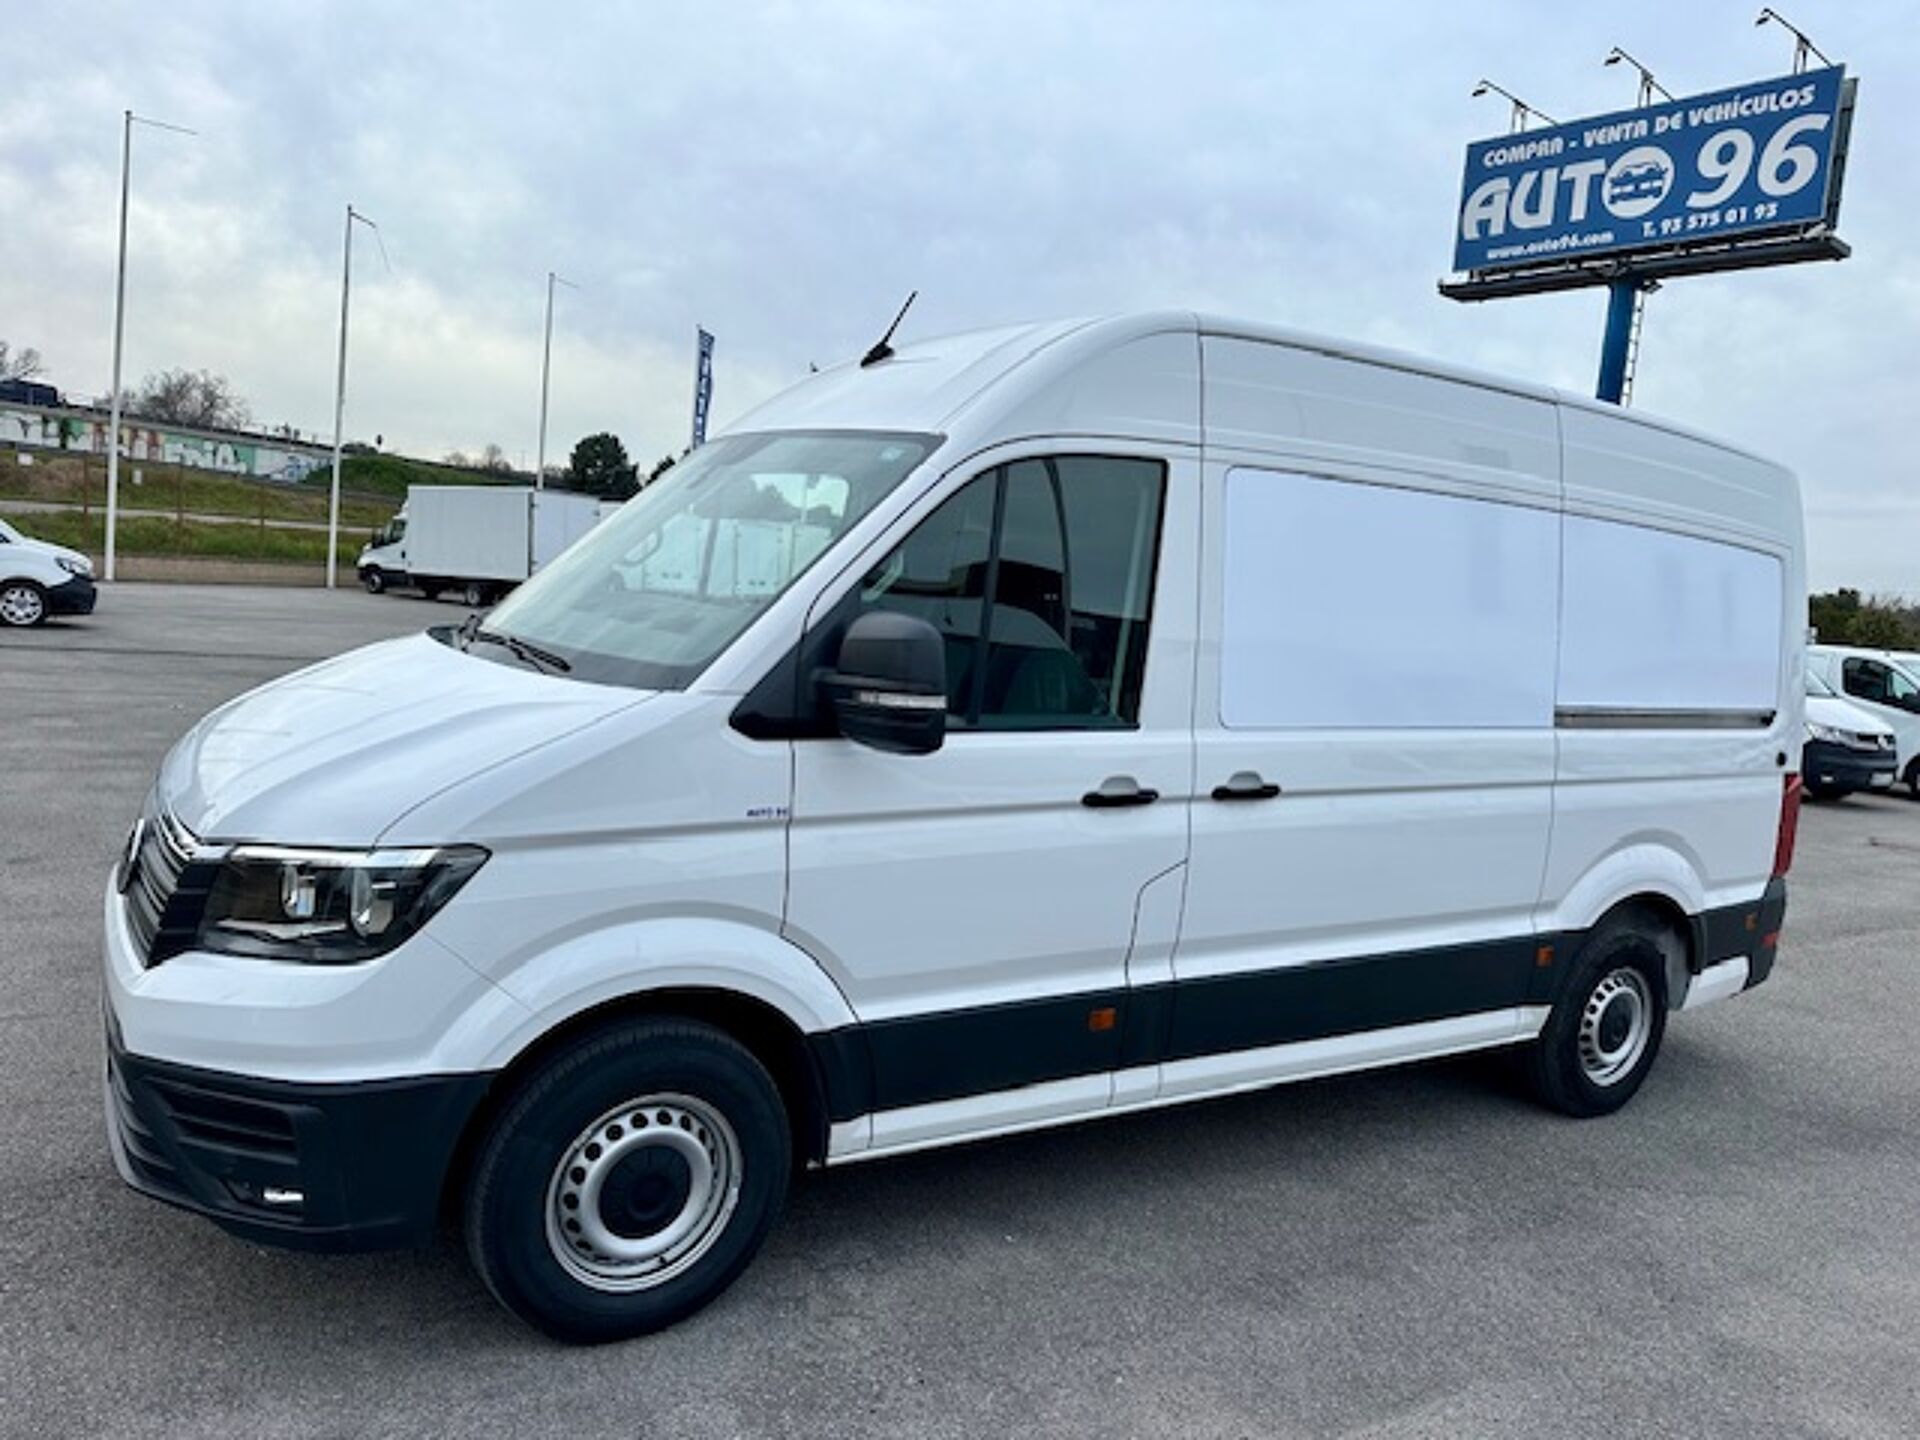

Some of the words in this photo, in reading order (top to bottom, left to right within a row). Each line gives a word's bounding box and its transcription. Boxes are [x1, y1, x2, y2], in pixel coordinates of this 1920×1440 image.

[1483, 136, 1564, 168] COMPRA
[1583, 119, 1648, 148] VENTA
[1654, 112, 1683, 134] DE
[1688, 84, 1816, 127] VEHÍCULOS
[1686, 113, 1830, 208] 96
[1487, 231, 1615, 259] www.auto96.com
[1661, 217, 1681, 235] 93
[1686, 210, 1720, 230] 575
[1724, 207, 1747, 223] 01
